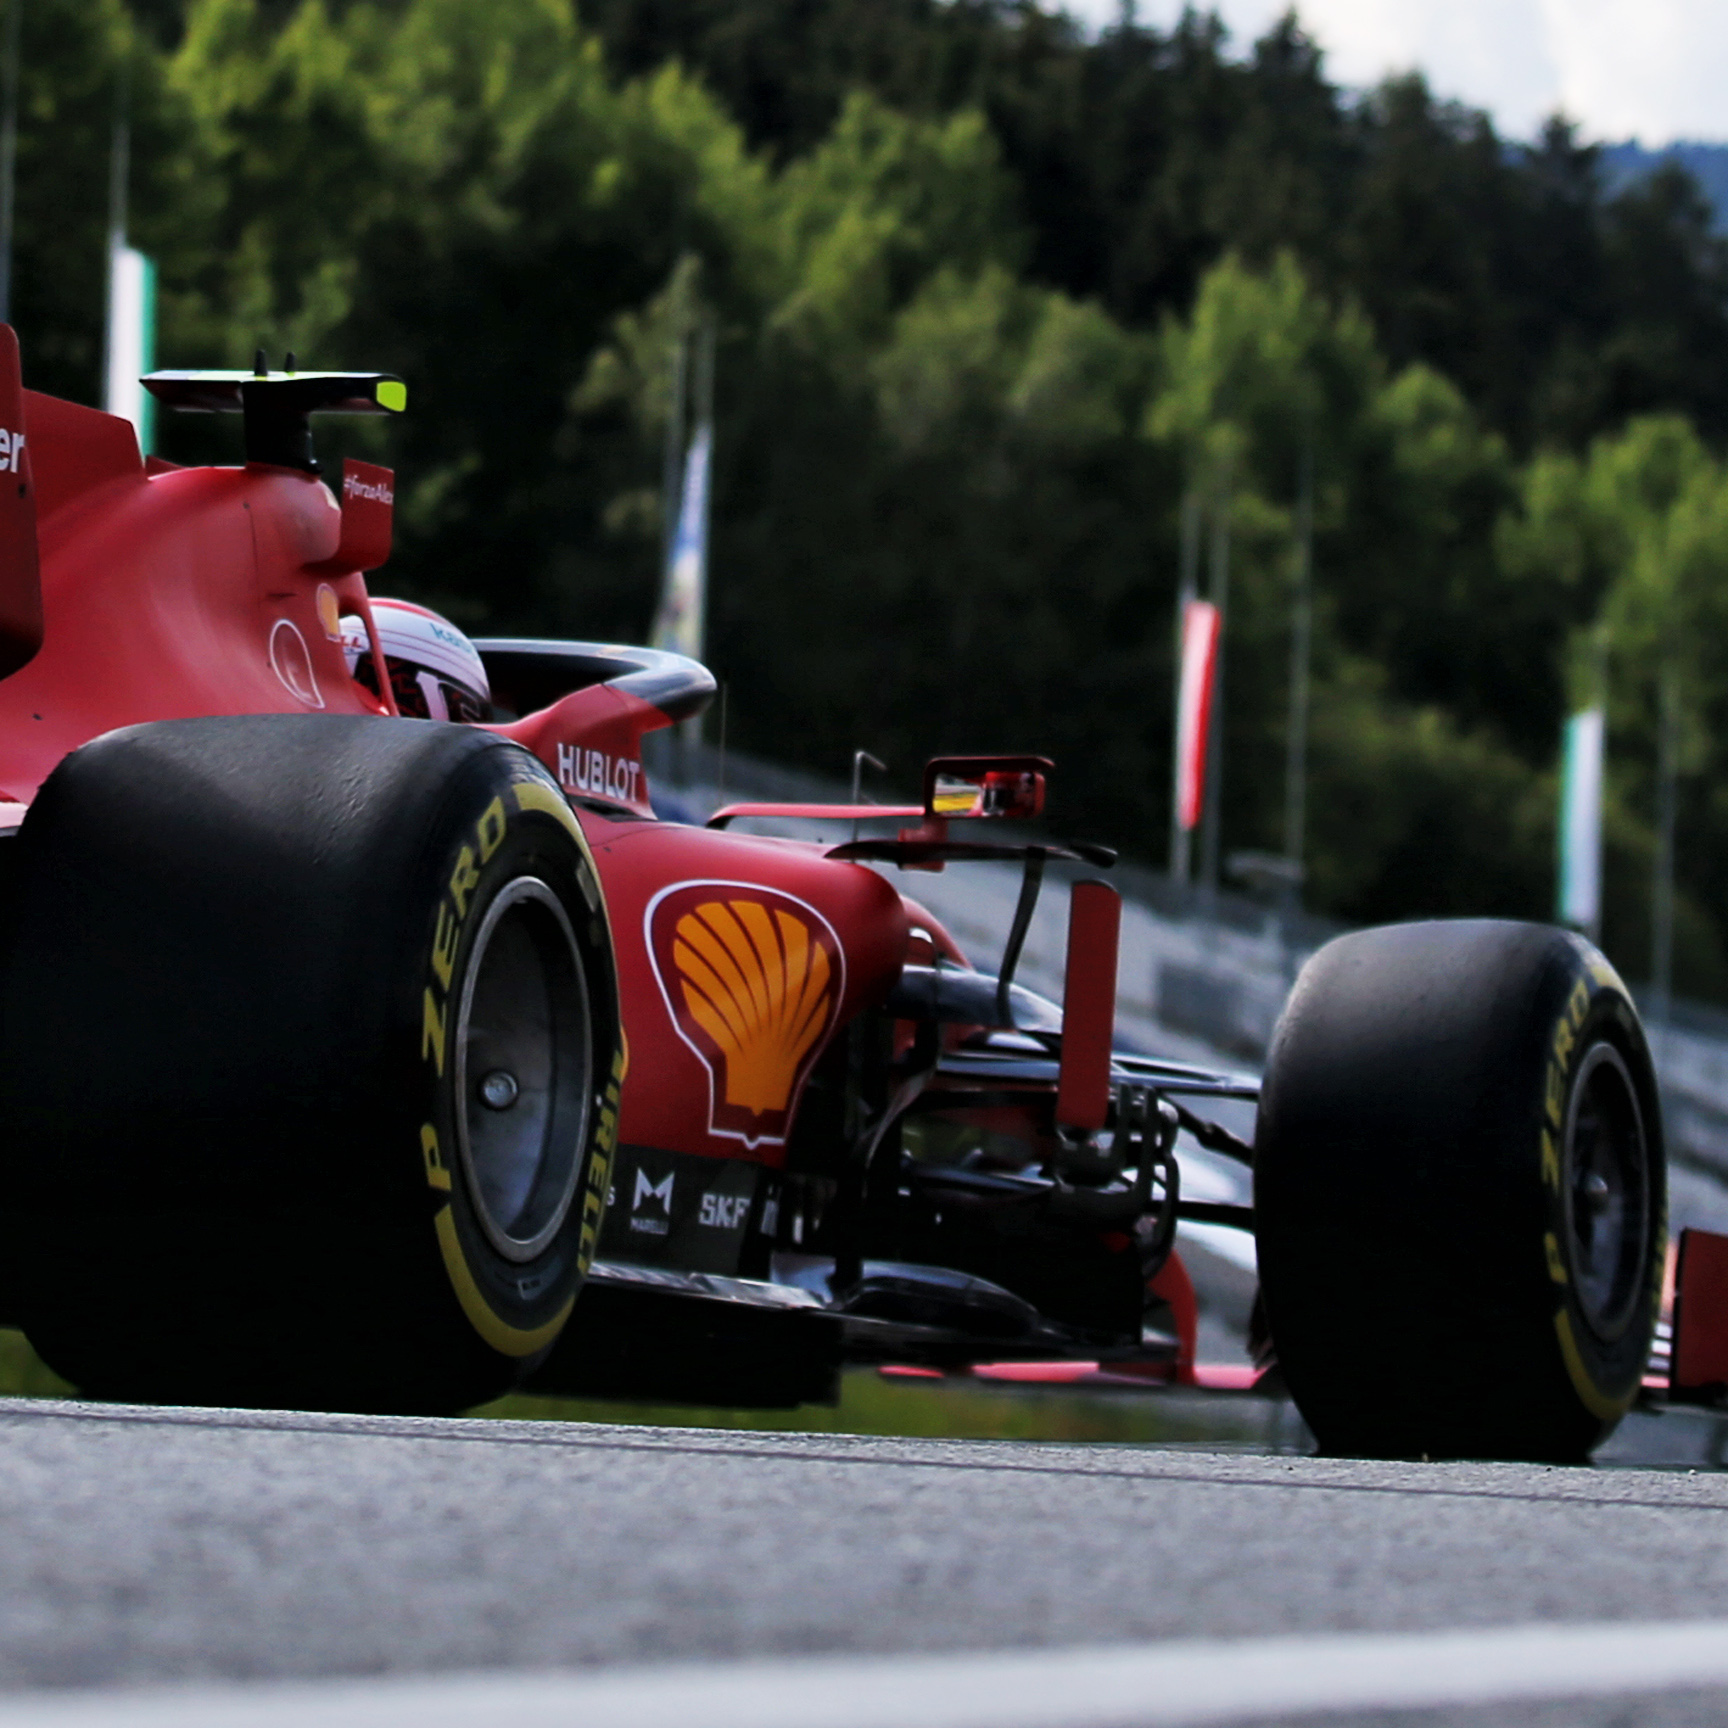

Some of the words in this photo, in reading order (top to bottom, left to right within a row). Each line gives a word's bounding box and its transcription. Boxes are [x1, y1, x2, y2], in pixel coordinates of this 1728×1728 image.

[557, 742, 640, 802] HUBLOT
[421, 794, 508, 1078] ZERO
[420, 1122, 452, 1192] P
[697, 1191, 753, 1230] SKF
